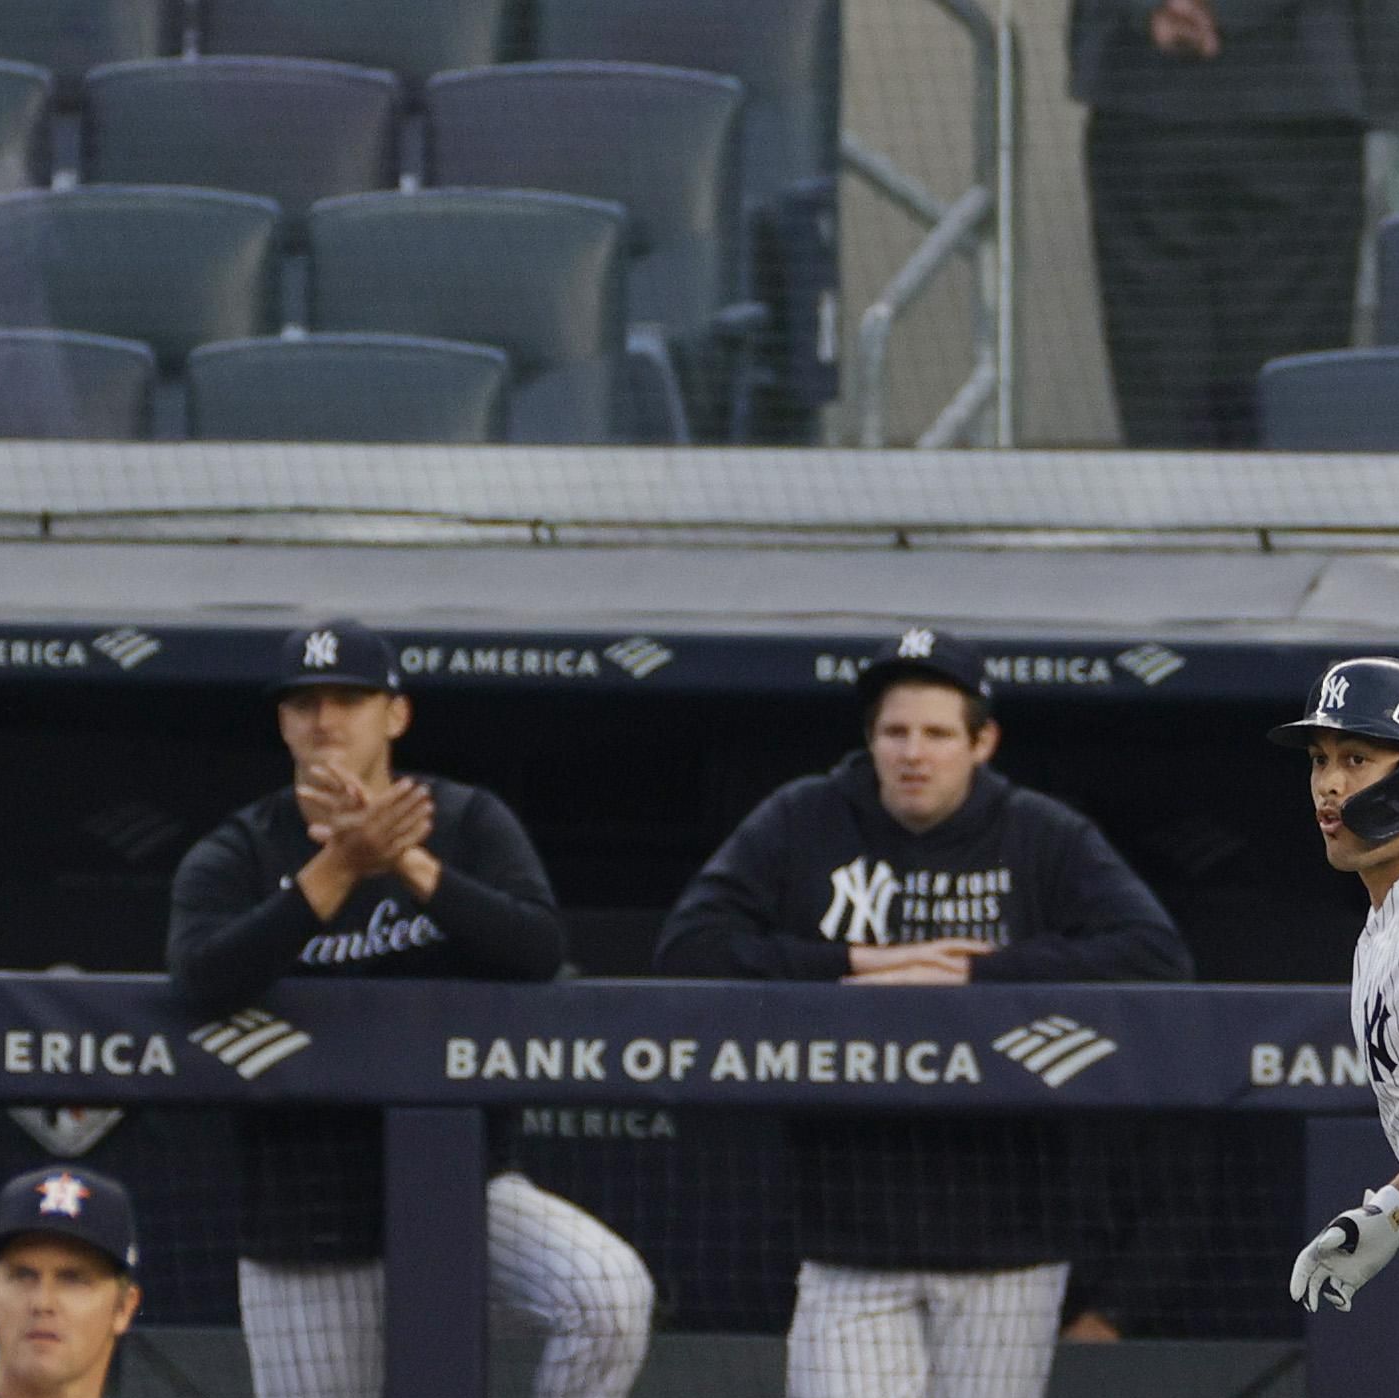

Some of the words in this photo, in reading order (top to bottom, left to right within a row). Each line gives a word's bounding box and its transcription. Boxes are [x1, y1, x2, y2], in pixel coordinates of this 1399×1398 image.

[303, 630, 338, 668] NY
[401, 646, 444, 675] OF
[449, 648, 600, 677] AMERICA
[983, 656, 1113, 685] MERICA
[1322, 674, 1351, 709] NY
[818, 855, 901, 946] NY
[445, 1038, 606, 1081] BANK
[622, 1038, 699, 1082] OF
[710, 1039, 981, 1084] AMERICA
[1250, 1043, 1369, 1088] BAN
[521, 1108, 676, 1138] MERICA
